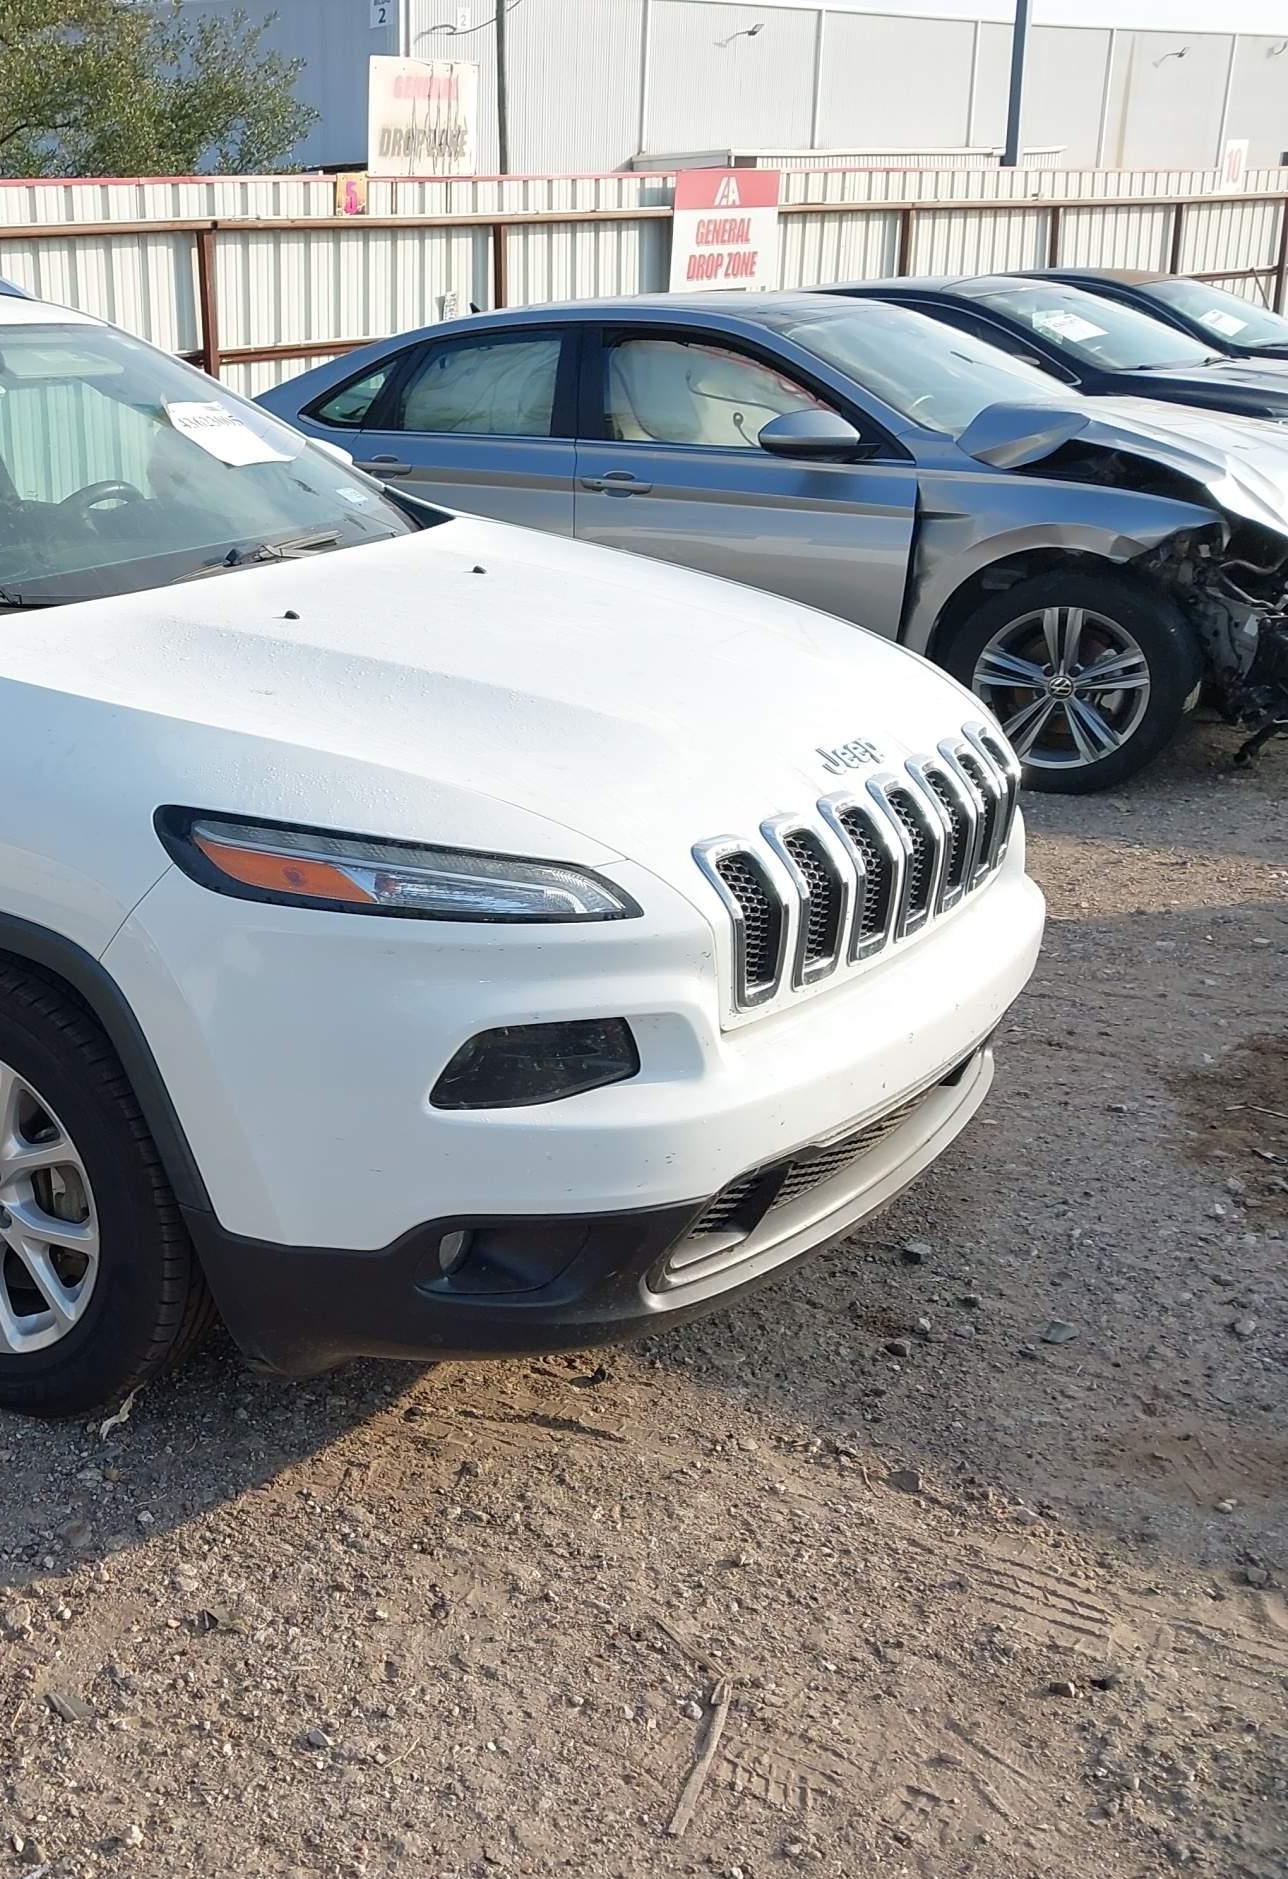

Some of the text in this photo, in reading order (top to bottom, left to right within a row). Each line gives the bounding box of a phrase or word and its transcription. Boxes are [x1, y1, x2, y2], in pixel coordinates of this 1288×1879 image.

[378, 127, 425, 158] DROP
[695, 217, 752, 247] GENERAL
[686, 251, 759, 281] DROP ZONE
[815, 738, 884, 776] Jeep
